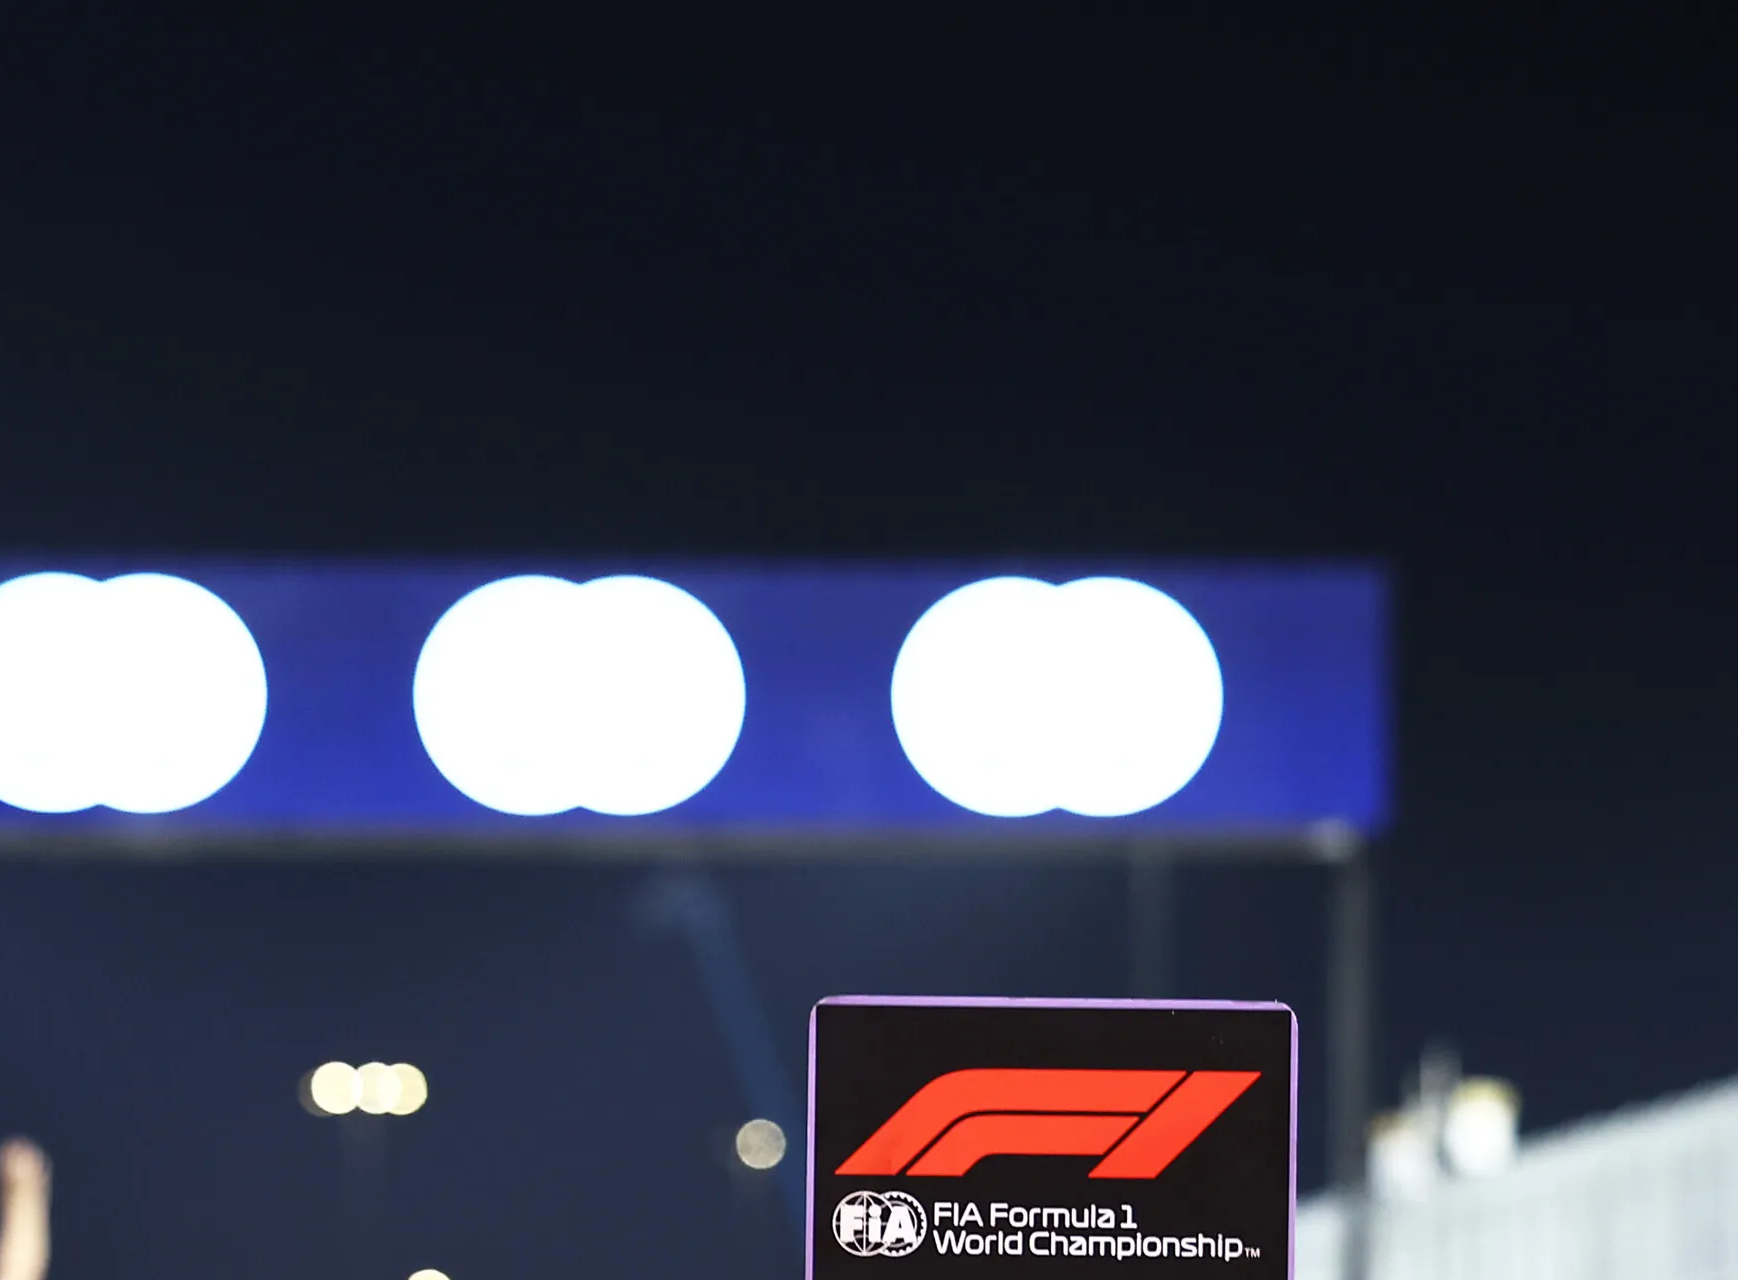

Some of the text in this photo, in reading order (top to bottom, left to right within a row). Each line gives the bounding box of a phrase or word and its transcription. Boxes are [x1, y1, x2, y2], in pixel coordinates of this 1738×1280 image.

[834, 1067, 1262, 1179] F1
[933, 1201, 1138, 1230] FIA Formula 1
[932, 1230, 1023, 1256] World
